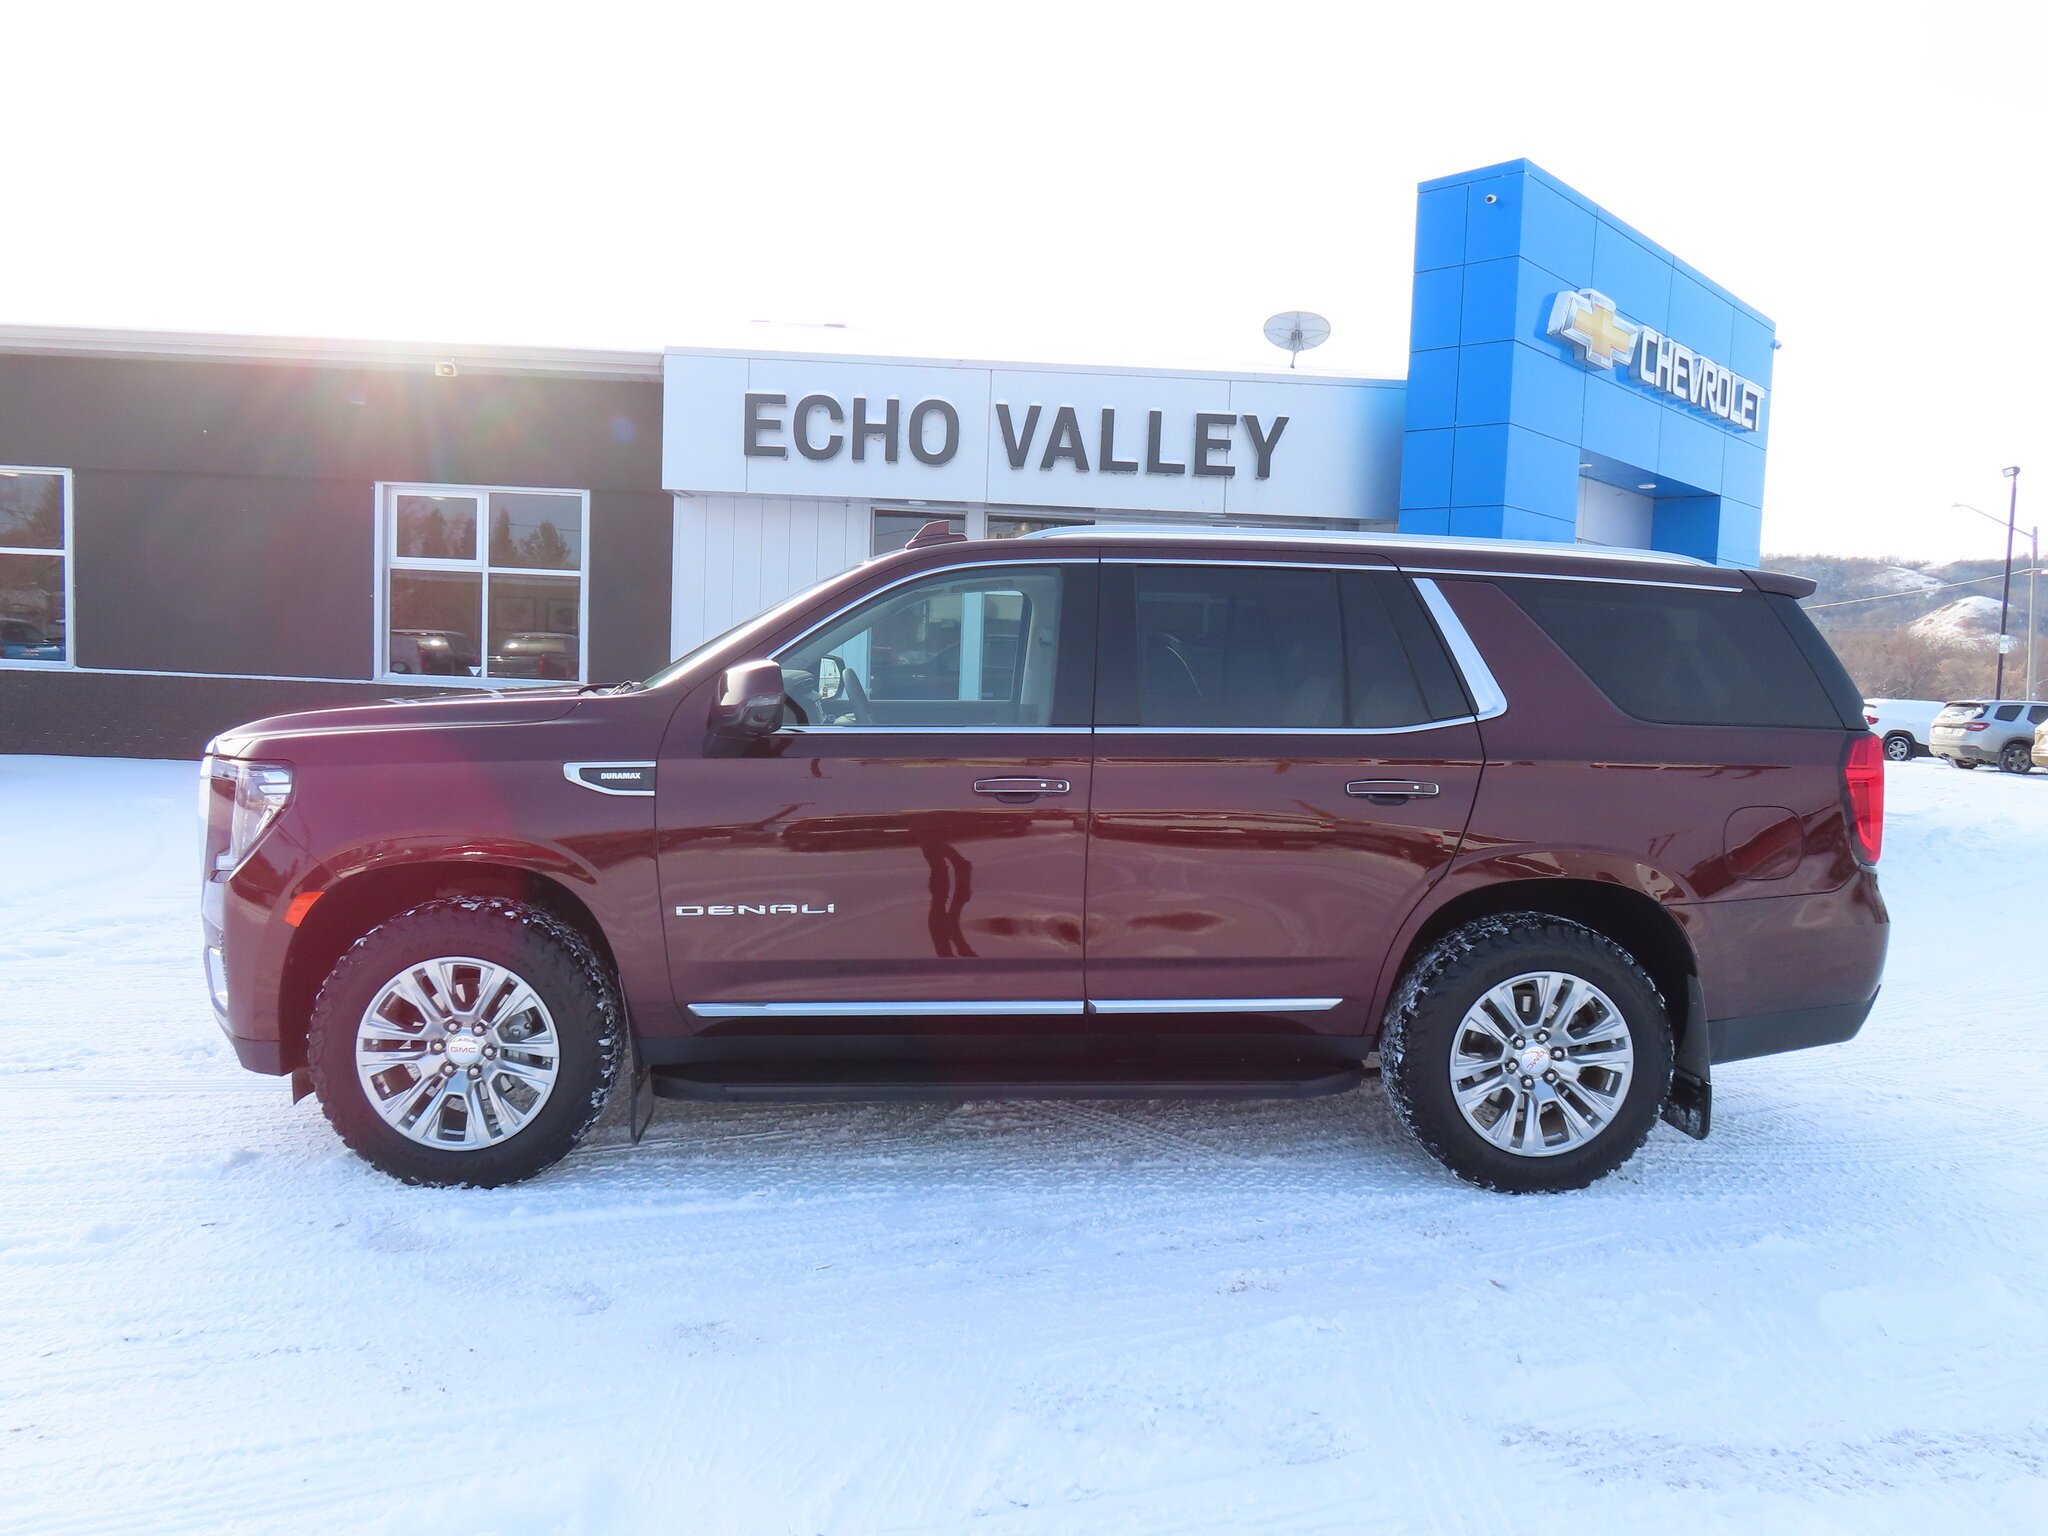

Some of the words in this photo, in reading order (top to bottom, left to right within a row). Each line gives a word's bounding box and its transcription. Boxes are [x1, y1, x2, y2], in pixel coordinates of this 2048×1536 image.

[1640, 329, 1765, 432] CHEVROLET
[743, 392, 960, 466] ECHO
[995, 403, 1290, 479] VALLEY
[600, 772, 641, 780] DURAMAX
[675, 903, 835, 916] DENALI
[1526, 1050, 1545, 1070] GMC
